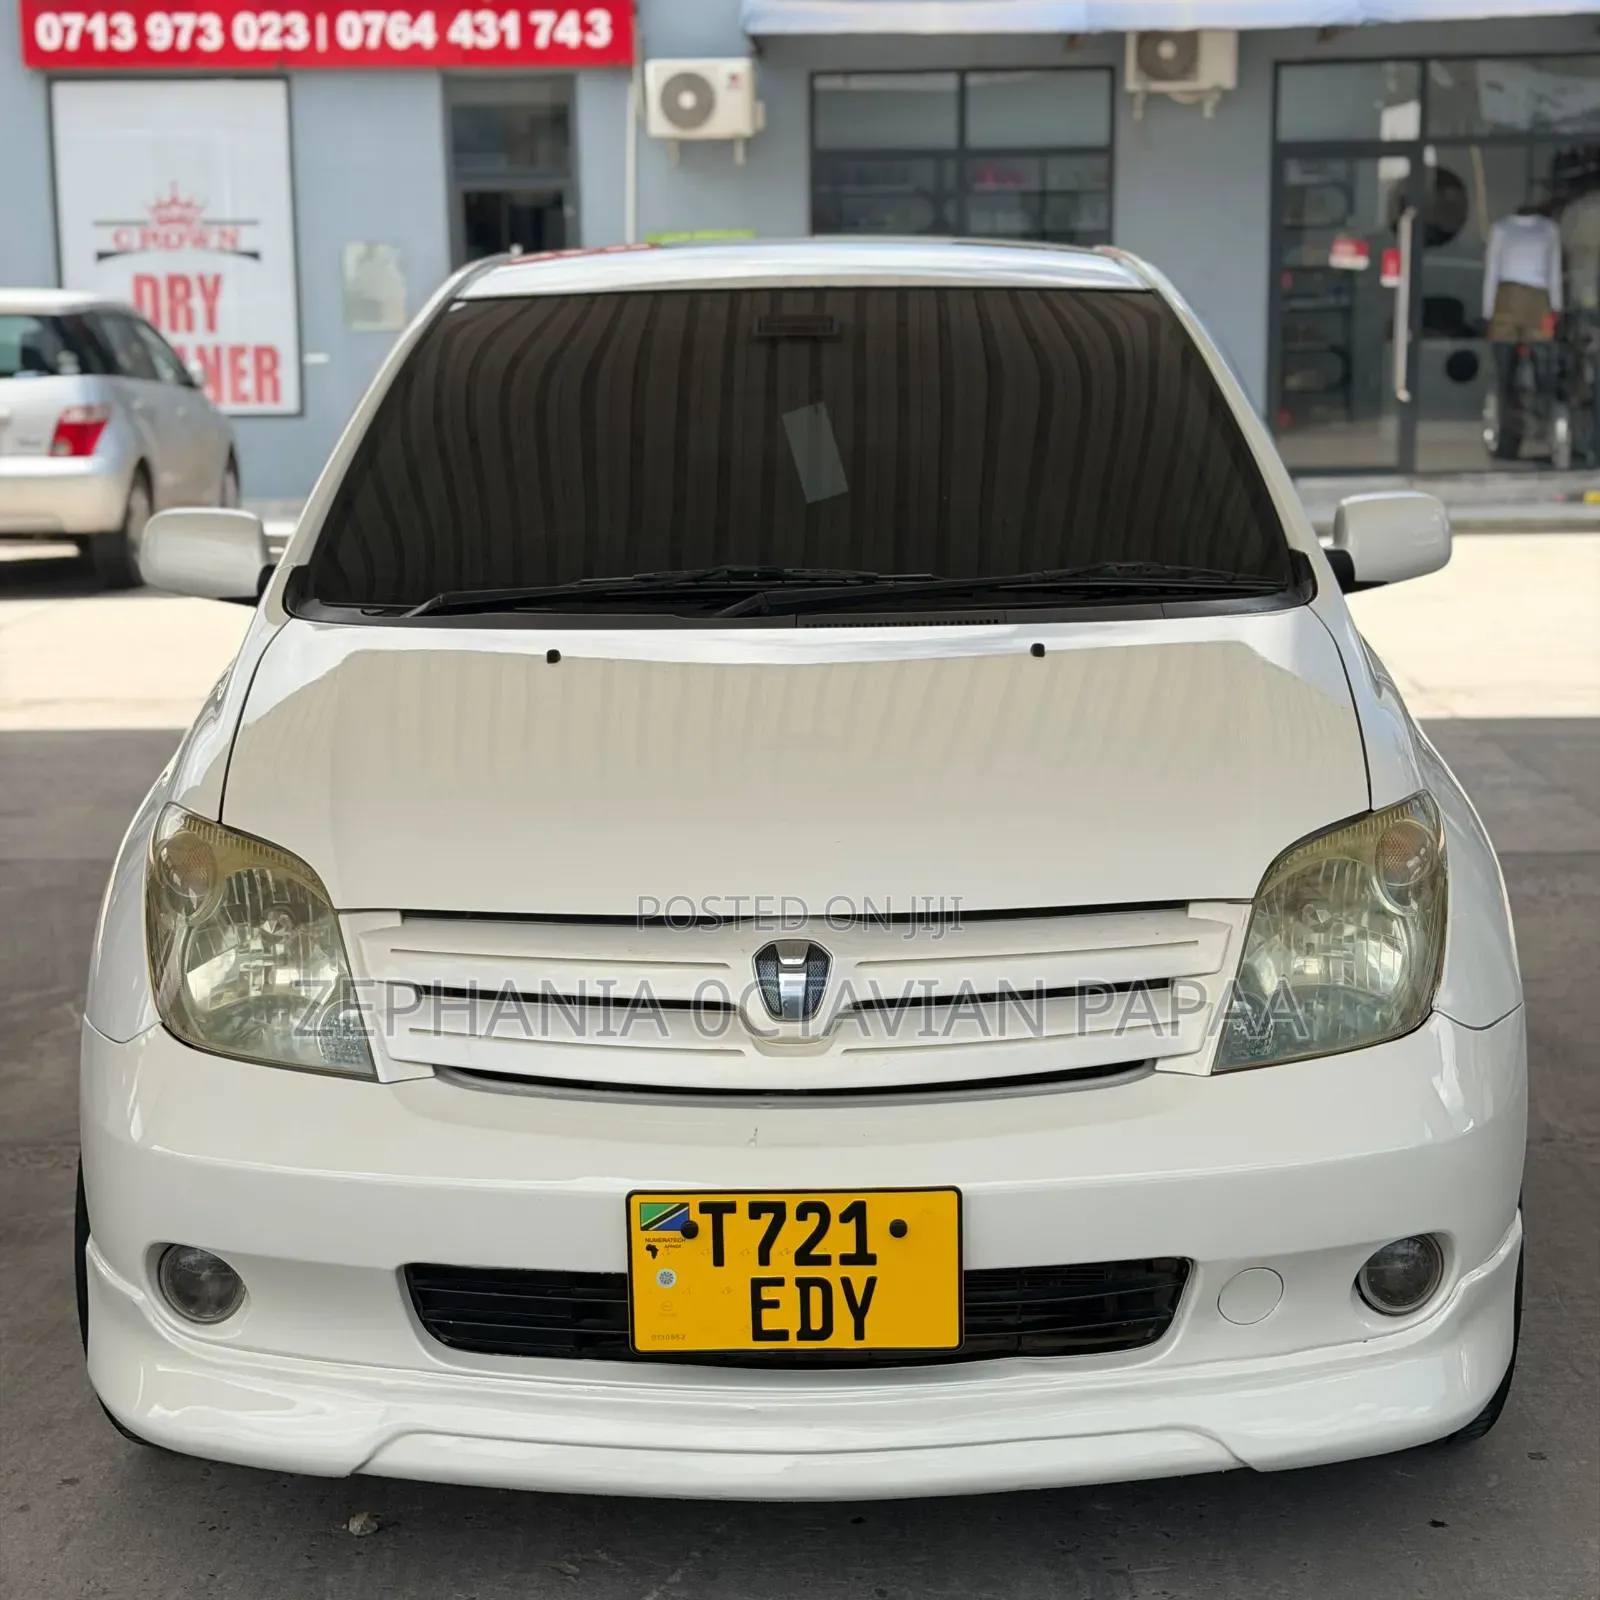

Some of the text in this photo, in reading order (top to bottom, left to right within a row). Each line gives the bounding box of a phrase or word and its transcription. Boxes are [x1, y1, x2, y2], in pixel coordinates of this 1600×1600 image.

[35, 11, 137, 51] 0713
[145, 11, 225, 52] 973
[231, 11, 310, 51] 023
[335, 10, 437, 50] 0764
[447, 9, 522, 49] 431
[529, 8, 613, 49] 743
[113, 228, 240, 250] CROWN
[132, 273, 222, 333] DRY
[750, 1276, 878, 1342] EDY
